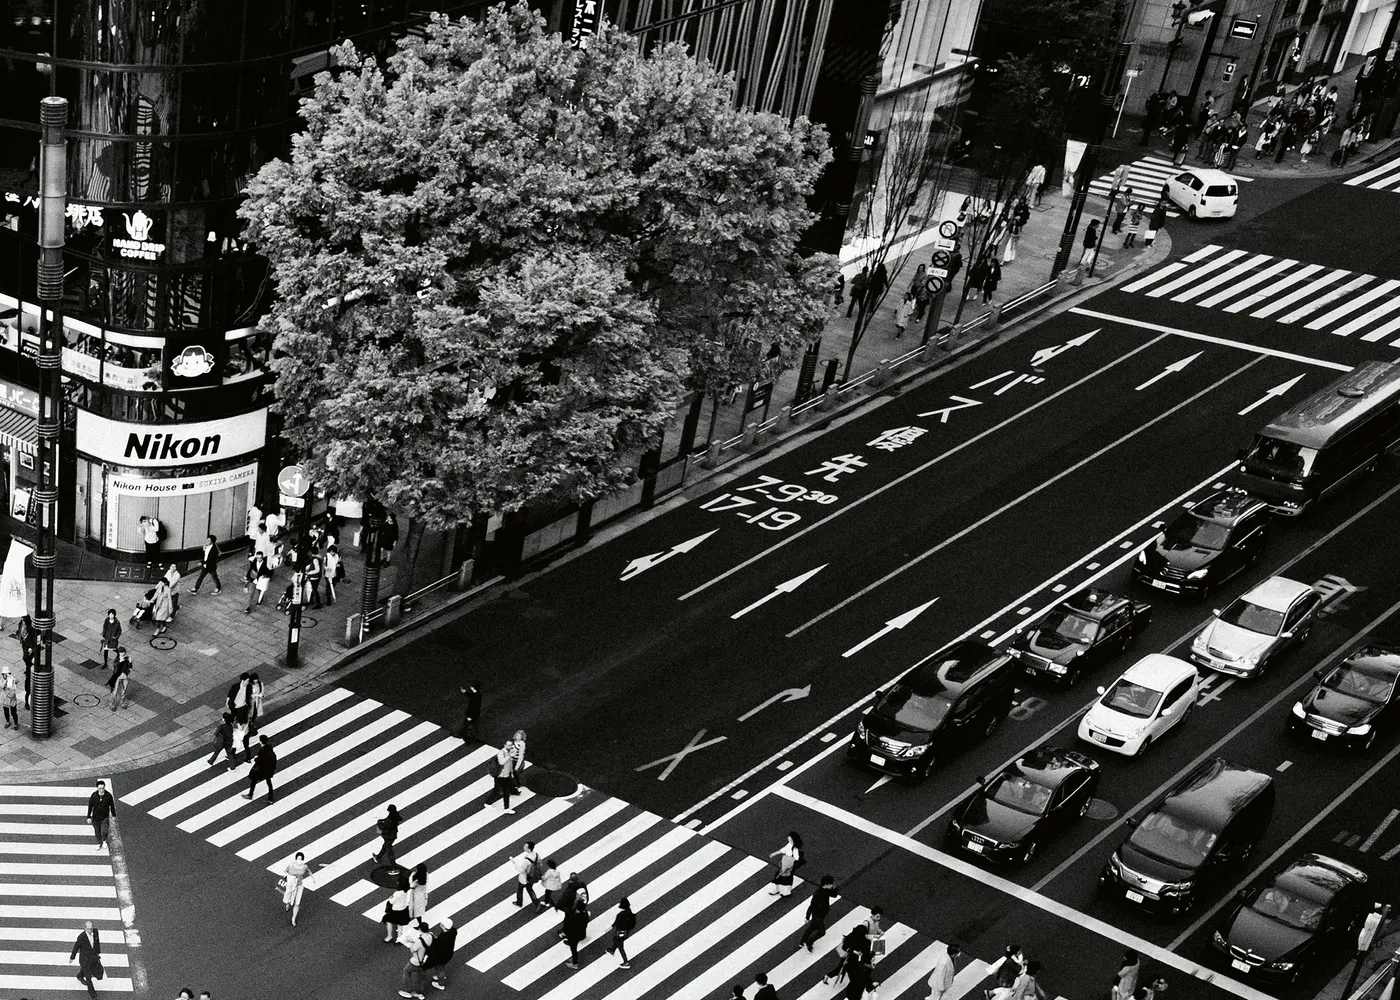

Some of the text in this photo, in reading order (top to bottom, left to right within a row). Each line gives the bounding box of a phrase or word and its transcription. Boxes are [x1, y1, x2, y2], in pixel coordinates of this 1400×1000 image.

[570, 0, 584, 47] レストラン
[112, 238, 166, 252] HAND DRIP
[119, 248, 157, 261] COFFEE
[123, 432, 222, 460] Nikon
[112, 480, 178, 492] Nikon House
[198, 468, 256, 489] SUKIYA CAMERA
[699, 493, 802, 531] 17-19
